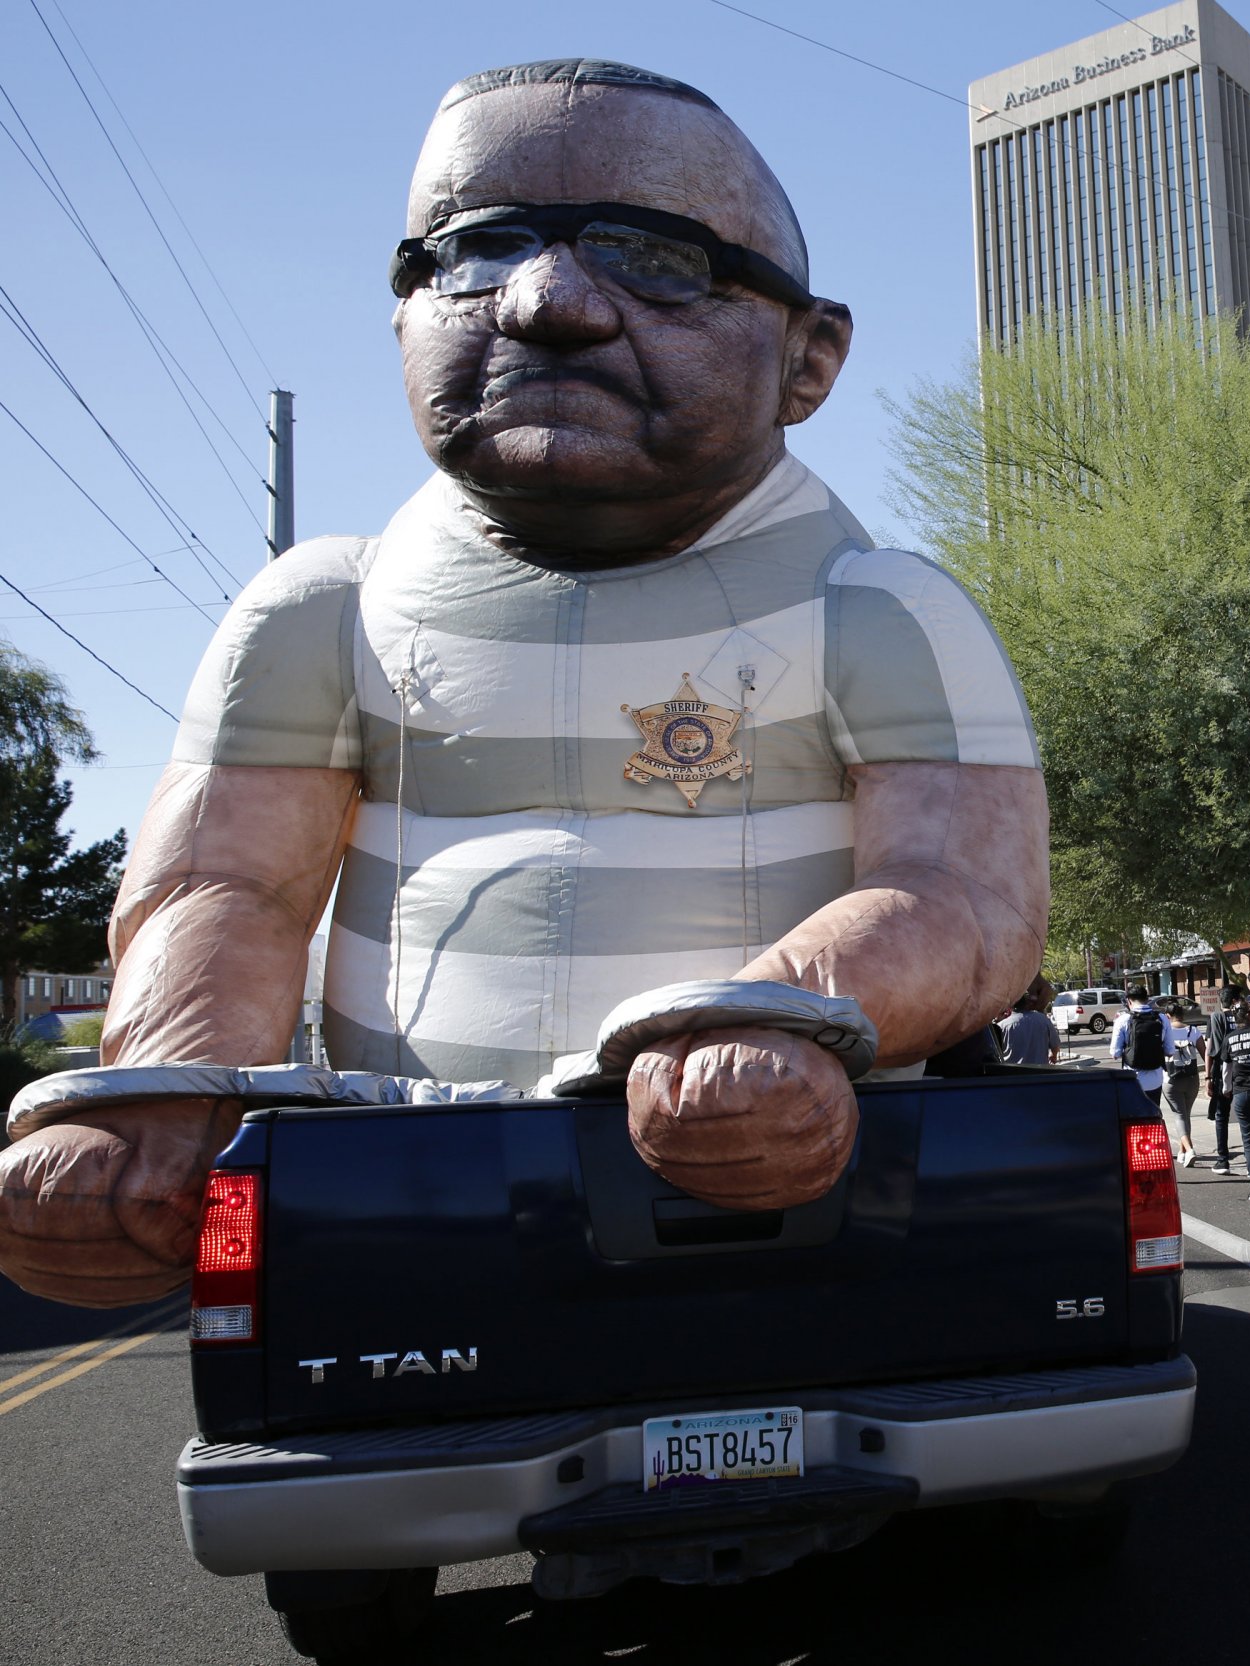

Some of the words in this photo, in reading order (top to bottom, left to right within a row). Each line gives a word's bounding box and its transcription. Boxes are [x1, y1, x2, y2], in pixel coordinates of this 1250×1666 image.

[1004, 76, 1070, 110] Arizona
[1072, 48, 1147, 84] Business
[1150, 25, 1196, 56] Bank
[664, 703, 709, 713] SHERIFF
[636, 753, 693, 773] MARICOPA
[698, 751, 739, 773] COUNTY
[664, 771, 715, 781] ARIZONA
[1056, 1297, 1104, 1319] 5.6
[686, 1416, 762, 1429] ARIZONA
[788, 1415, 798, 1424] 16
[667, 1427, 792, 1474] BST8457
[738, 1468, 754, 1476] GRAND
[756, 1466, 776, 1474] CANYON
